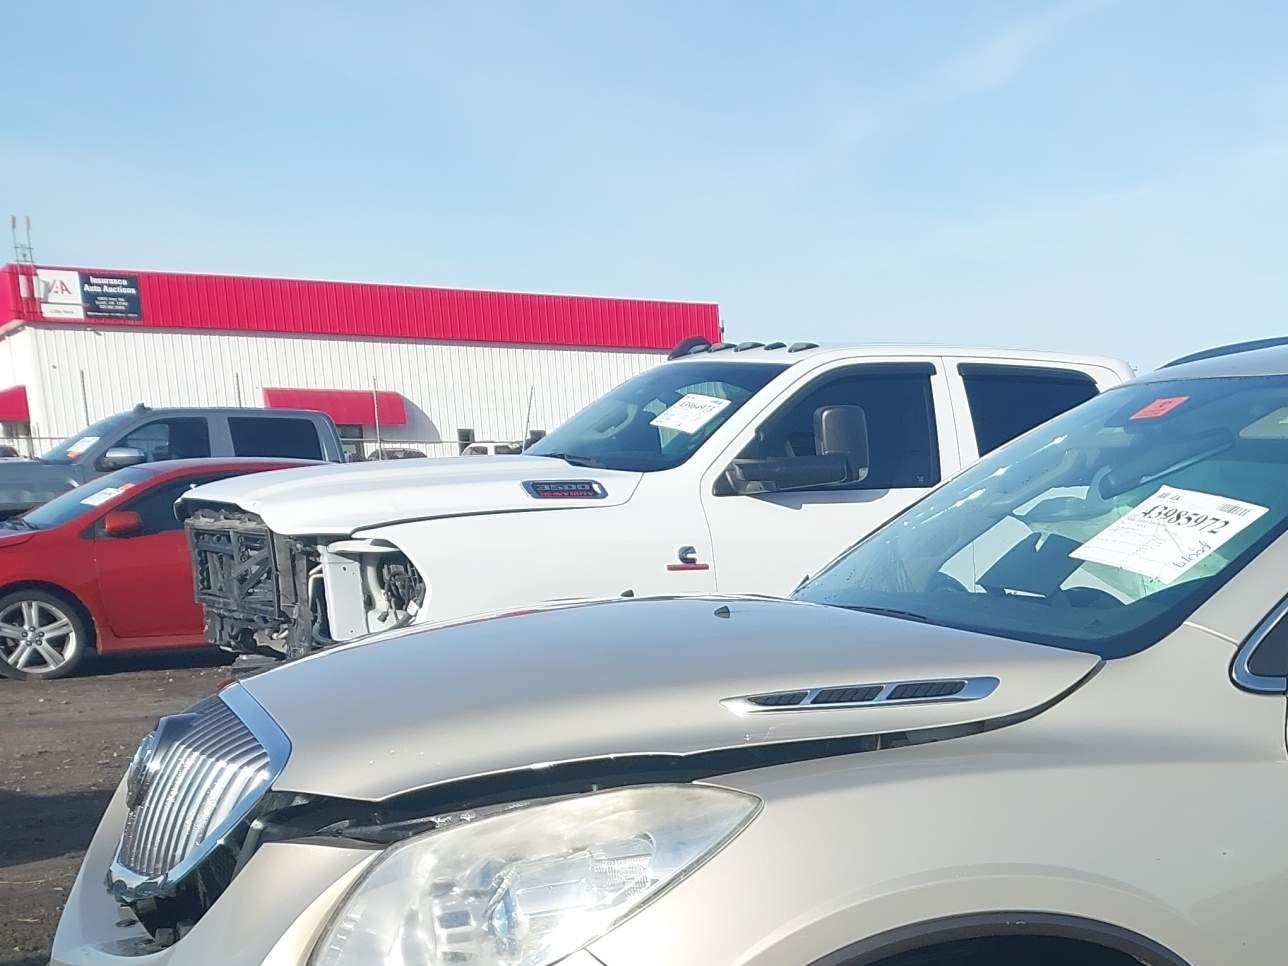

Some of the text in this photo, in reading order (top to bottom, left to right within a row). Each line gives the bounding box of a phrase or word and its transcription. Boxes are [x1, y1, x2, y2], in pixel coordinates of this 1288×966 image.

[83, 283, 137, 295] Auto Auctions
[536, 483, 590, 492] 3500
[1141, 504, 1231, 535] 43985972
